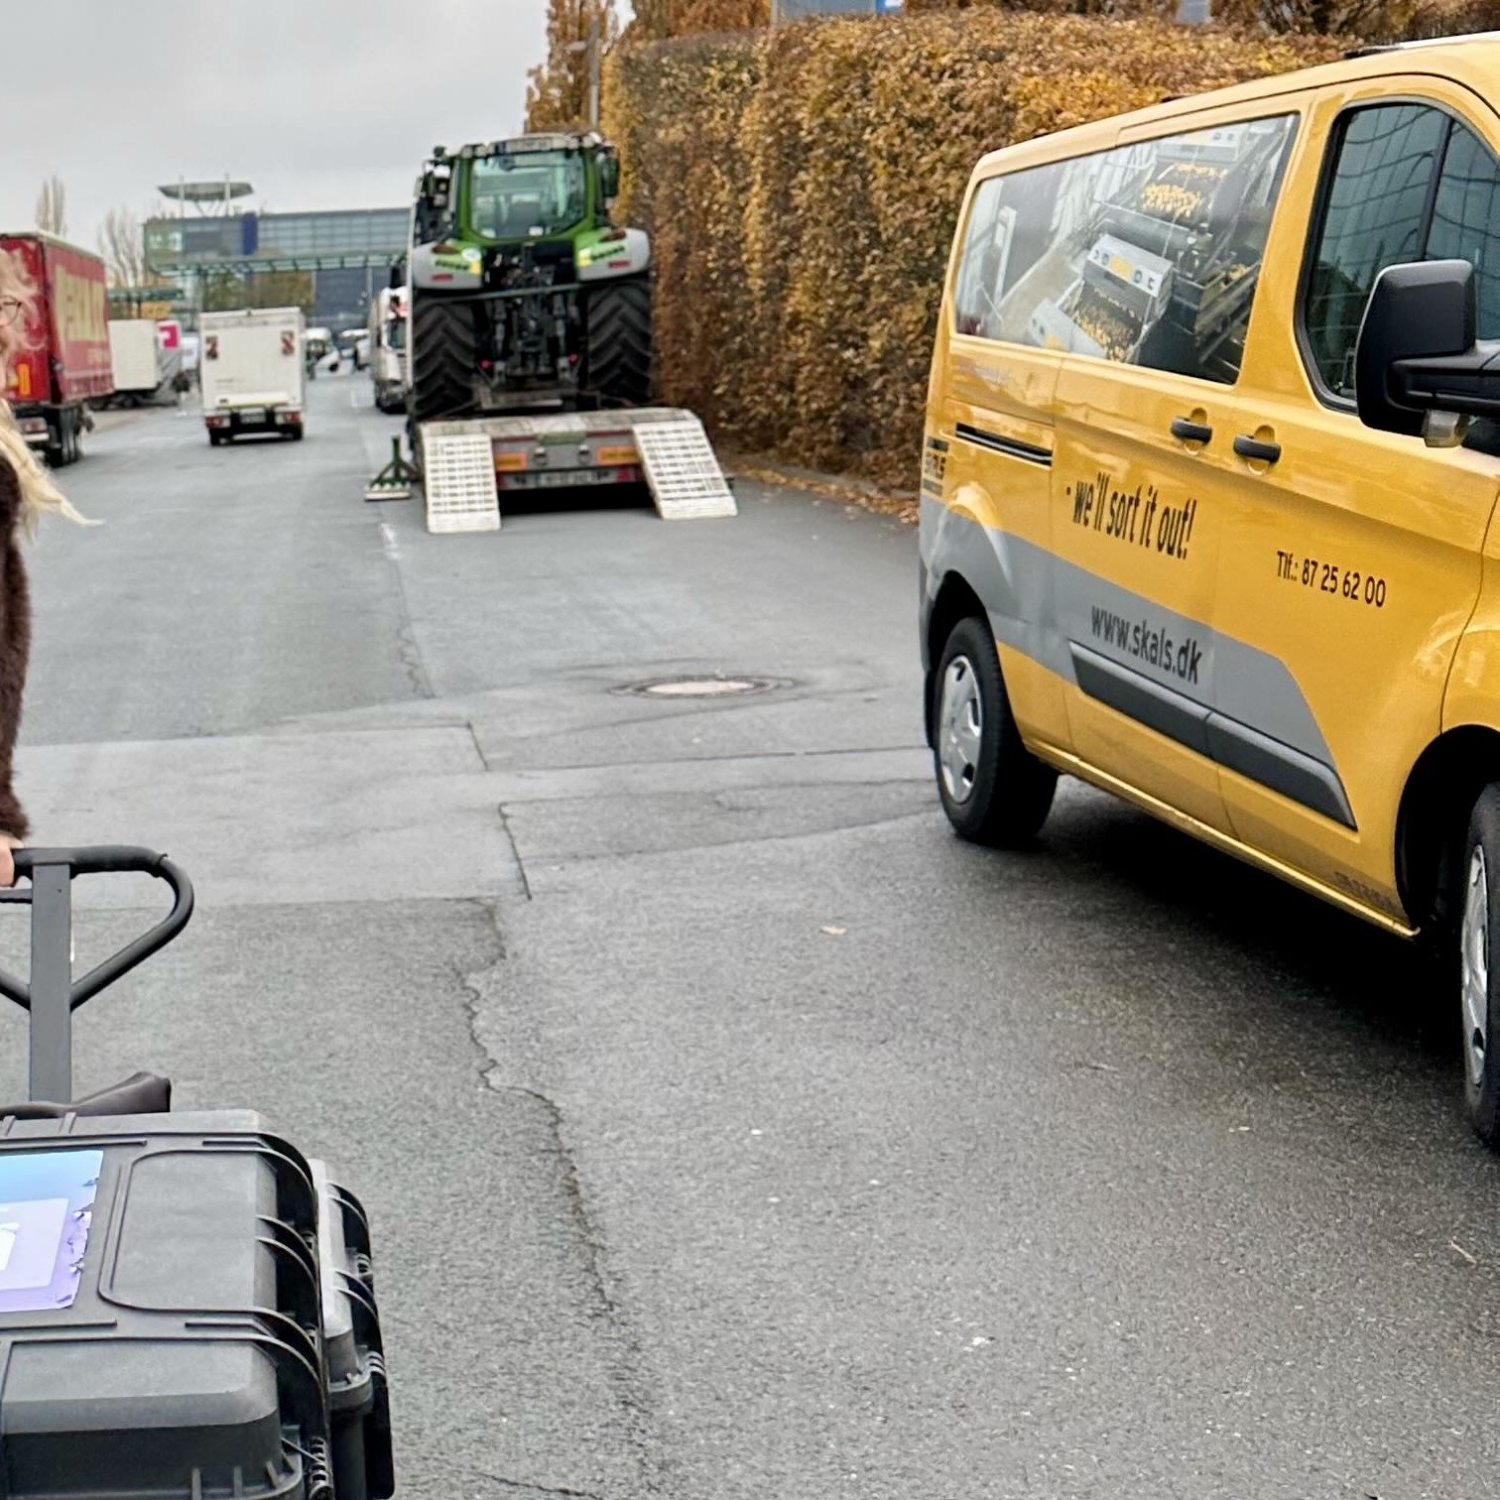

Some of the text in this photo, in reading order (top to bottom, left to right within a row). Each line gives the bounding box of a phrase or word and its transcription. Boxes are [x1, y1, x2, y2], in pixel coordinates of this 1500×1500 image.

[1073, 471, 1111, 532] we'll
[1106, 484, 1142, 543] sort
[1139, 485, 1159, 548] it
[1157, 498, 1197, 560] out!
[1302, 558, 1319, 587] 87
[1321, 564, 1338, 593] 25
[1342, 571, 1361, 600] 62
[1364, 576, 1386, 608] 00
[1091, 604, 1203, 685] www.skals.dk
